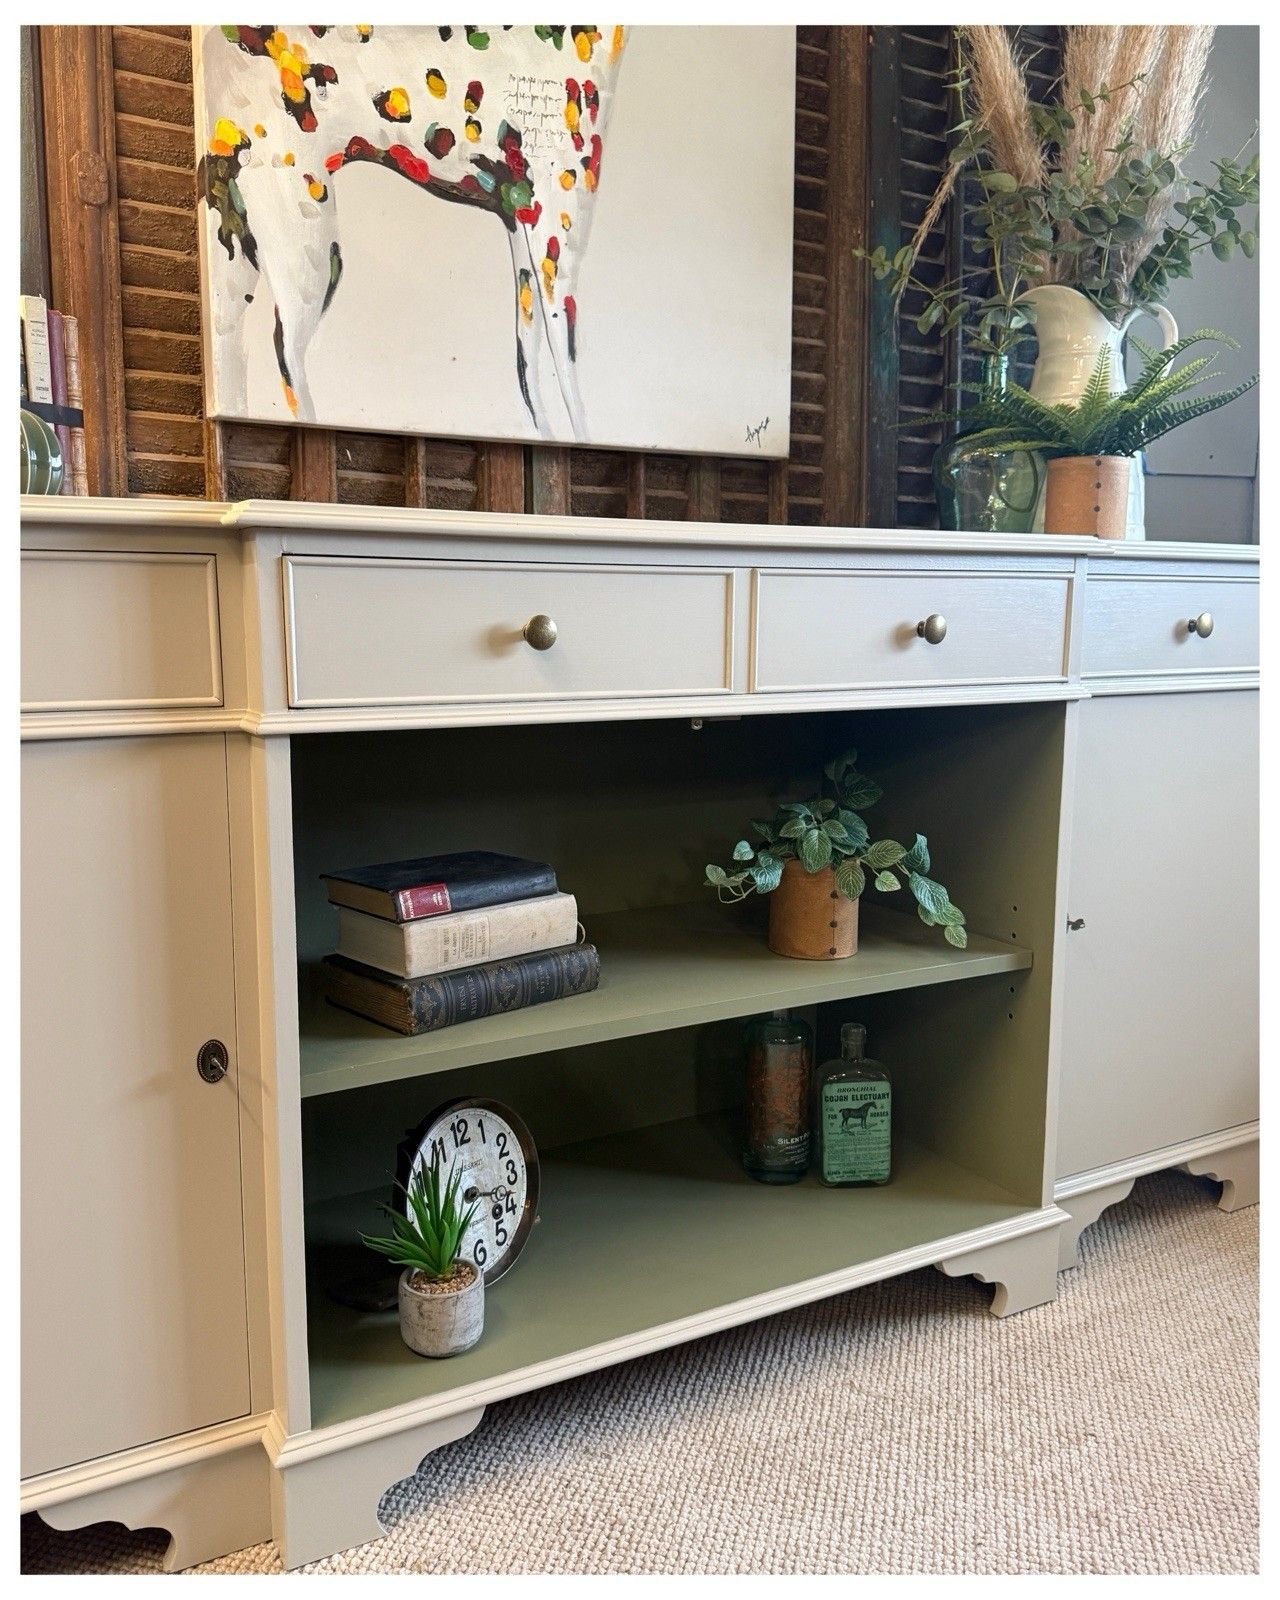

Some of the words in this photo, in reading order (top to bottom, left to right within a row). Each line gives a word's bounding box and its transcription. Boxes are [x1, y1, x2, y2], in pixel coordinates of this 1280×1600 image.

[824, 1094, 848, 1103] COUGH
[450, 1118, 471, 1149] 12
[477, 1118, 486, 1144] 1
[496, 1132, 510, 1160] 2
[506, 1159, 518, 1186] 3
[505, 1191, 518, 1216] 4
[496, 1219, 508, 1247] 5
[473, 1238, 487, 1267] 6
